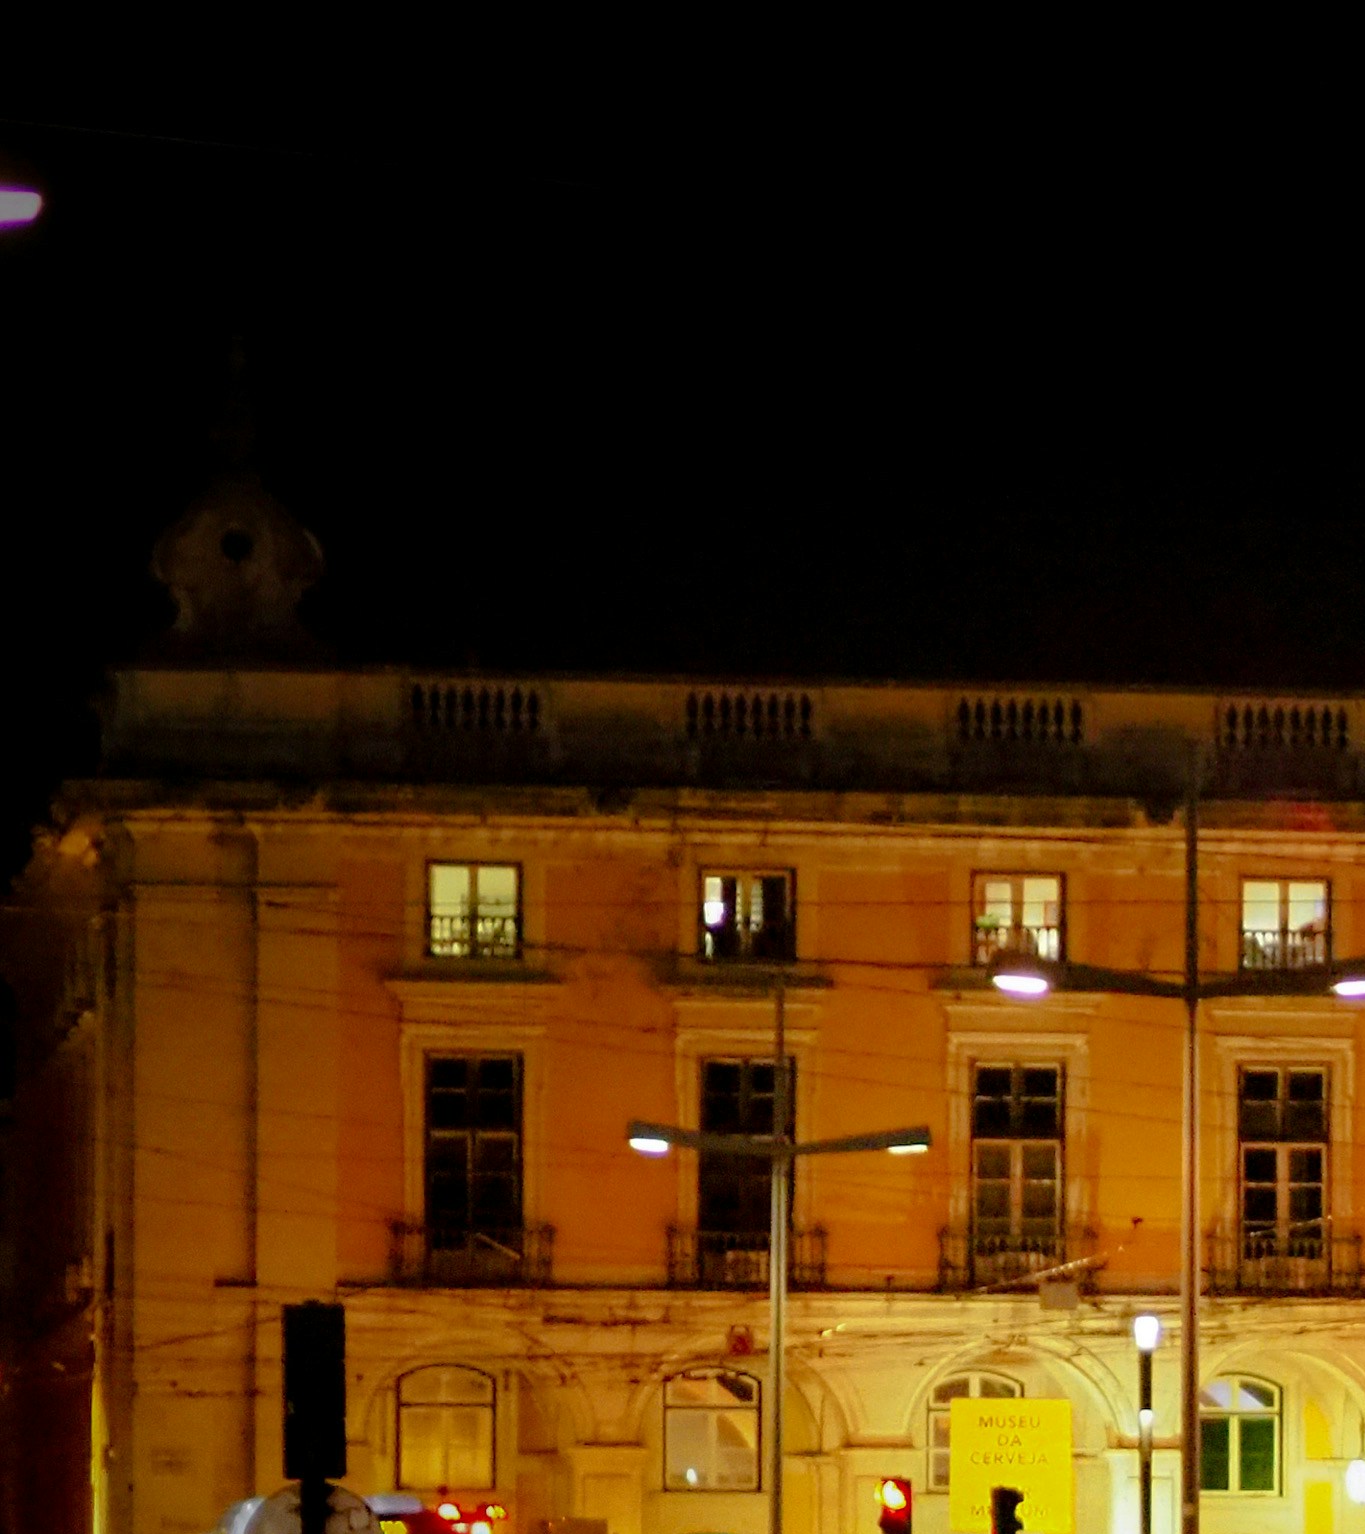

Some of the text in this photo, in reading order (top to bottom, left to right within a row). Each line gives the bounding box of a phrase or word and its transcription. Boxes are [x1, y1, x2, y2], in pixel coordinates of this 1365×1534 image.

[978, 1415, 1041, 1429] MUSEU
[997, 1434, 1022, 1447] DA
[970, 1451, 1048, 1465] CERVEJA
